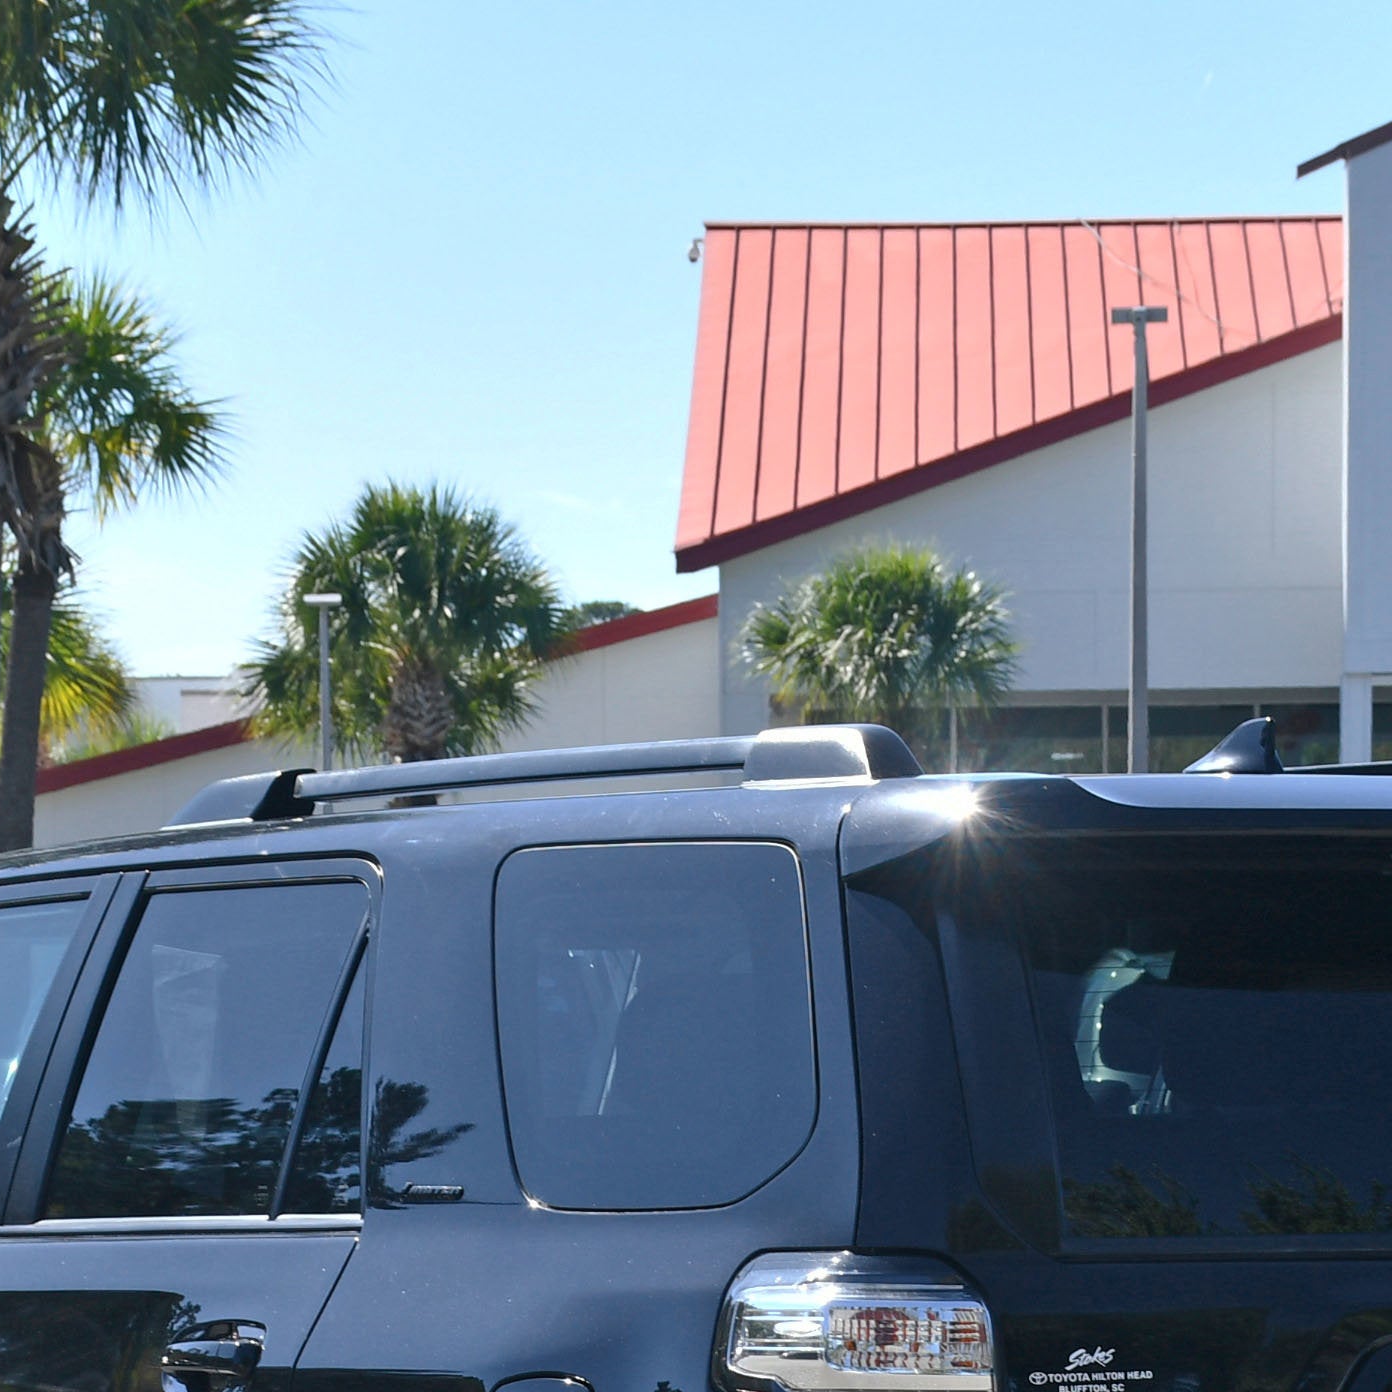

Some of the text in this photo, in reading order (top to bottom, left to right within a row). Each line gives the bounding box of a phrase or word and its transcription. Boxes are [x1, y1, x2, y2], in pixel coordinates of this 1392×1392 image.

[1064, 1346, 1116, 1371] Stokes
[1047, 1370, 1153, 1383] TOYOTA HILTON HEAD
[1111, 1383, 1125, 1392] SC
